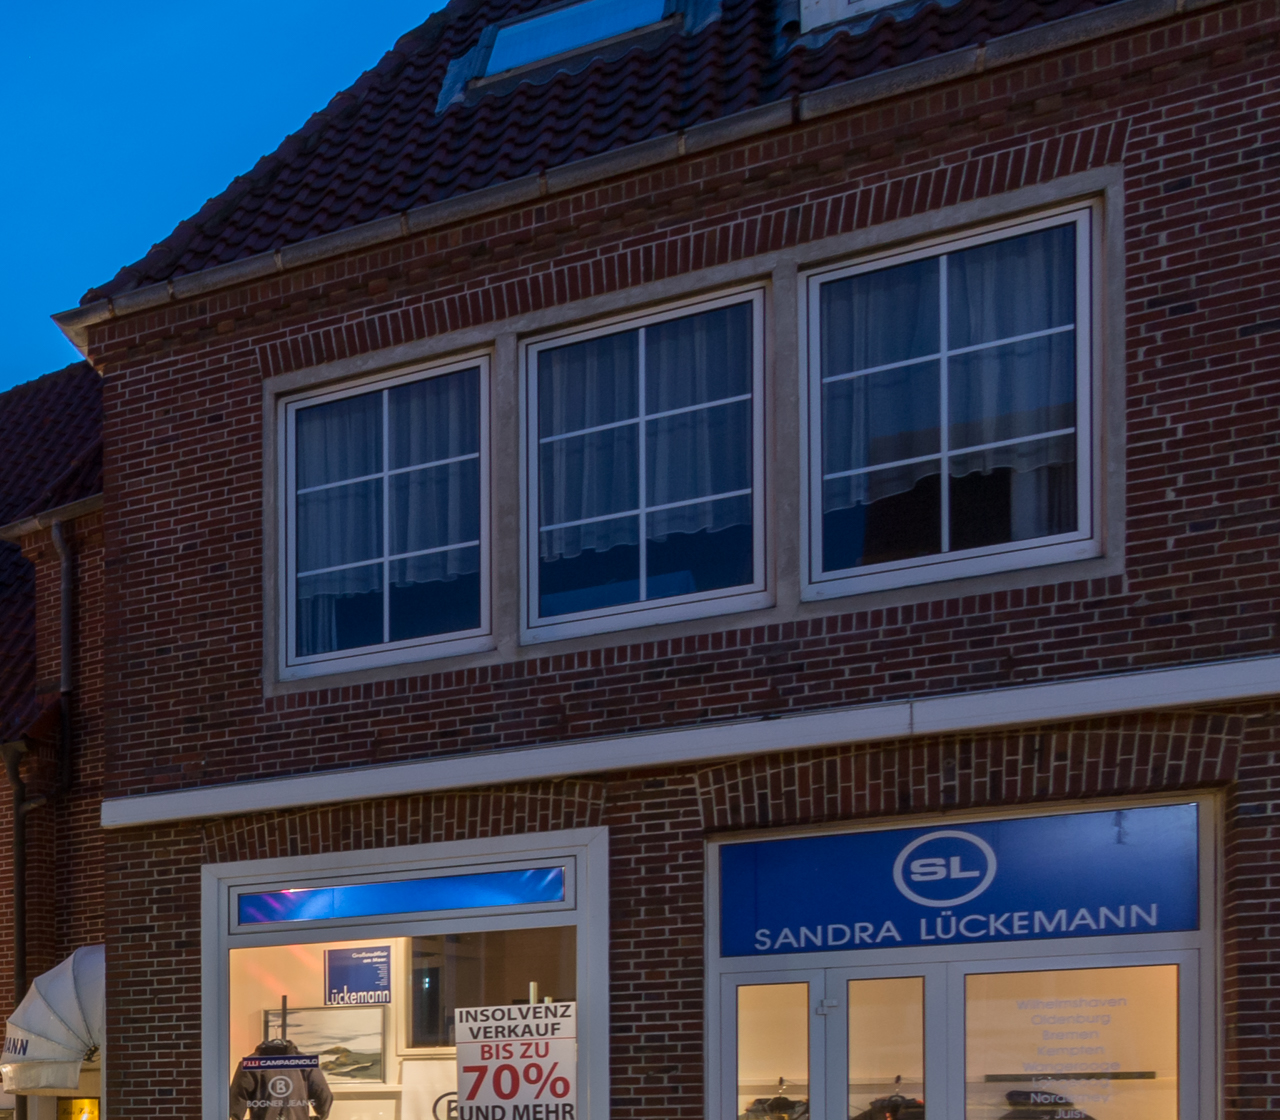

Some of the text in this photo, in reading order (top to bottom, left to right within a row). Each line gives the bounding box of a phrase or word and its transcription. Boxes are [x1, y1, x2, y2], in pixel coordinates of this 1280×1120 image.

[909, 857, 981, 883] SL
[754, 902, 1159, 951] SANDRA LÜCKEMANN
[1016, 997, 1128, 1010] Wilhelmshaven
[459, 1004, 572, 1023] INSOLVENZ
[1030, 1014, 1112, 1026] Oldenburg
[469, 1022, 561, 1040] VERKAUF
[1042, 1029, 1100, 1041] Bremen
[480, 1041, 550, 1061] BIS ZU
[1037, 1046, 1106, 1057] Kempten
[260, 1058, 318, 1066] CAMPAGNOLO
[1022, 1061, 1122, 1074] Wangerooge
[462, 1061, 571, 1101] 70%
[246, 1099, 316, 1108] BOGNER JEANS
[1054, 1108, 1087, 1119] Juist
